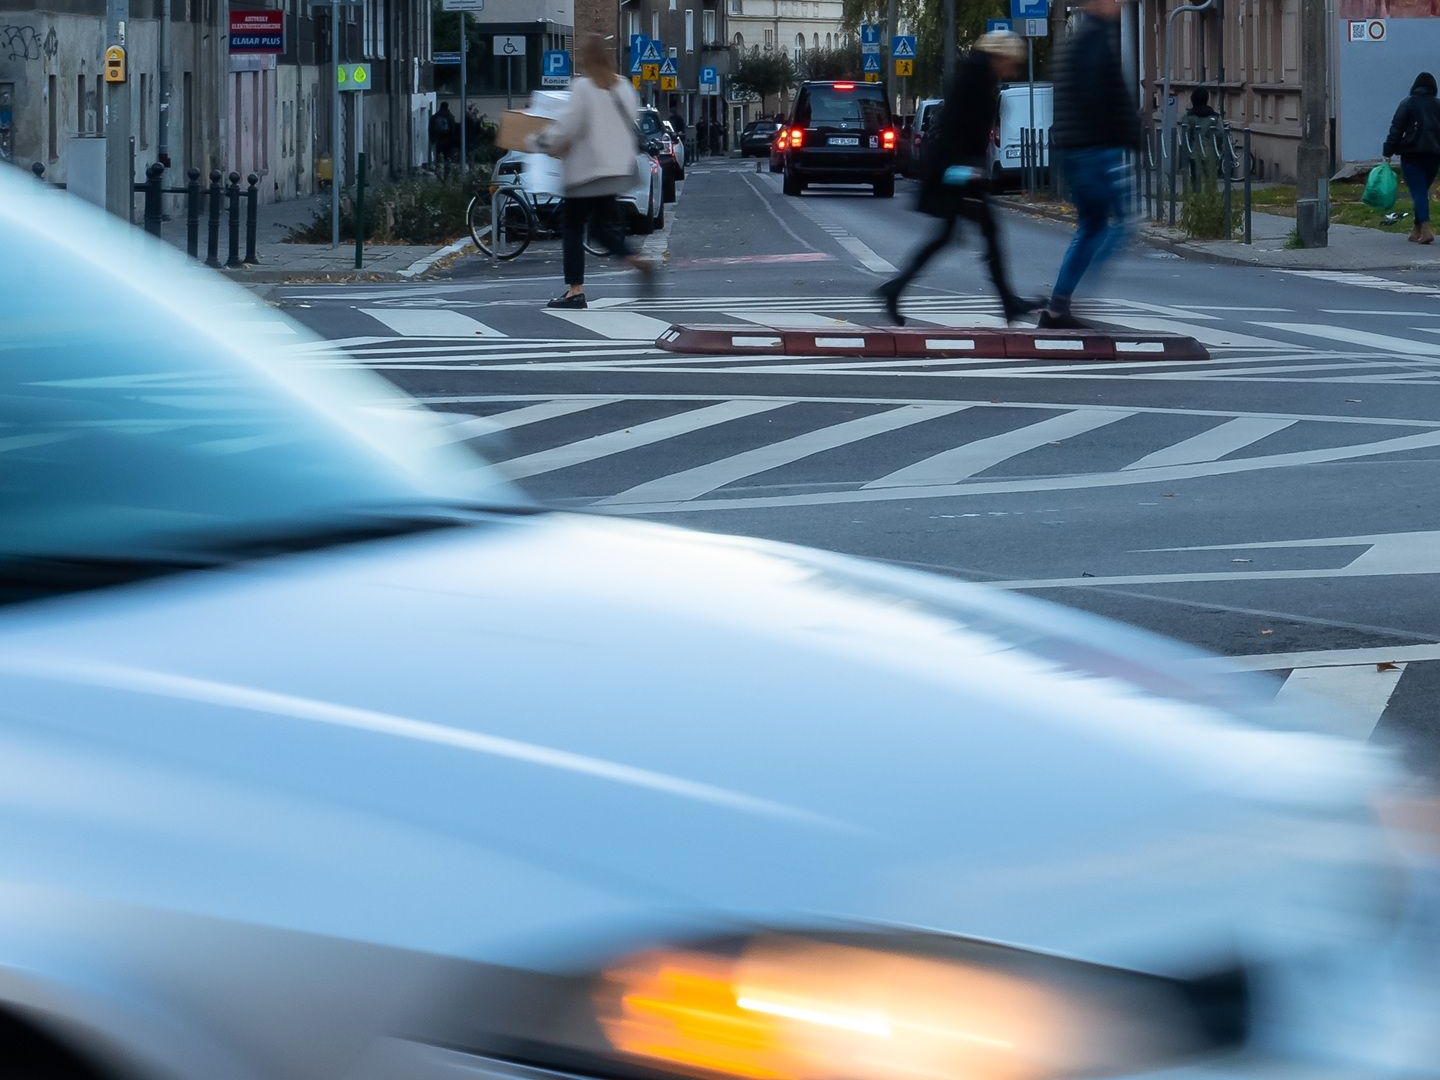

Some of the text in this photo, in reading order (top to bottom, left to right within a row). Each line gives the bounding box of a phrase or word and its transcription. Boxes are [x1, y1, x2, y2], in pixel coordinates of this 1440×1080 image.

[232, 37, 280, 45] ELMAR PLUS
[550, 54, 563, 72] P
[704, 69, 713, 81] P
